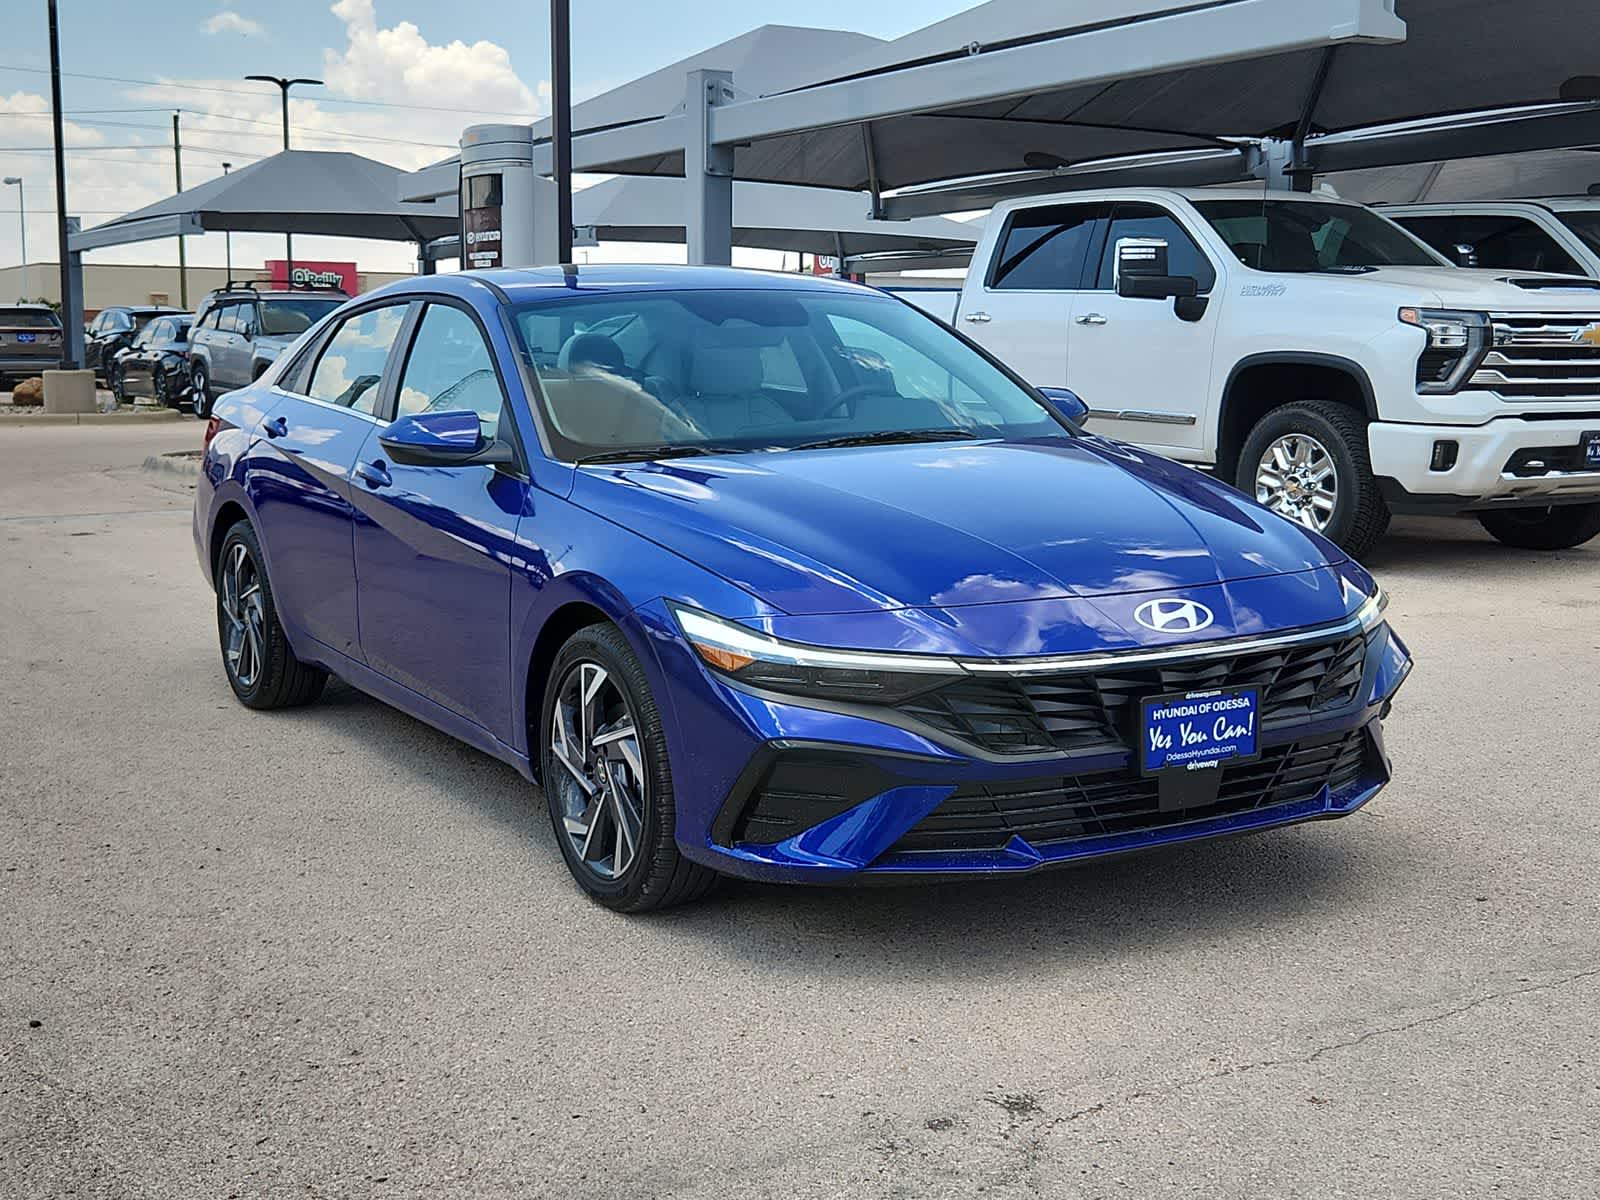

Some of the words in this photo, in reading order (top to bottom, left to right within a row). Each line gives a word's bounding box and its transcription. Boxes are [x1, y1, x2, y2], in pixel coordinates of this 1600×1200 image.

[292, 268, 343, 288] O'Reilly
[1185, 690, 1222, 700] driveway.com
[1153, 705, 1198, 720] HYUNDAI
[1199, 703, 1212, 714] OF
[1212, 697, 1250, 712] ODESSA
[1149, 726, 1173, 751] Yes
[1180, 721, 1208, 747] You
[1213, 712, 1254, 741] Can!
[1166, 745, 1237, 762] OdessaHyundai.com
[1186, 759, 1219, 770] driveway
